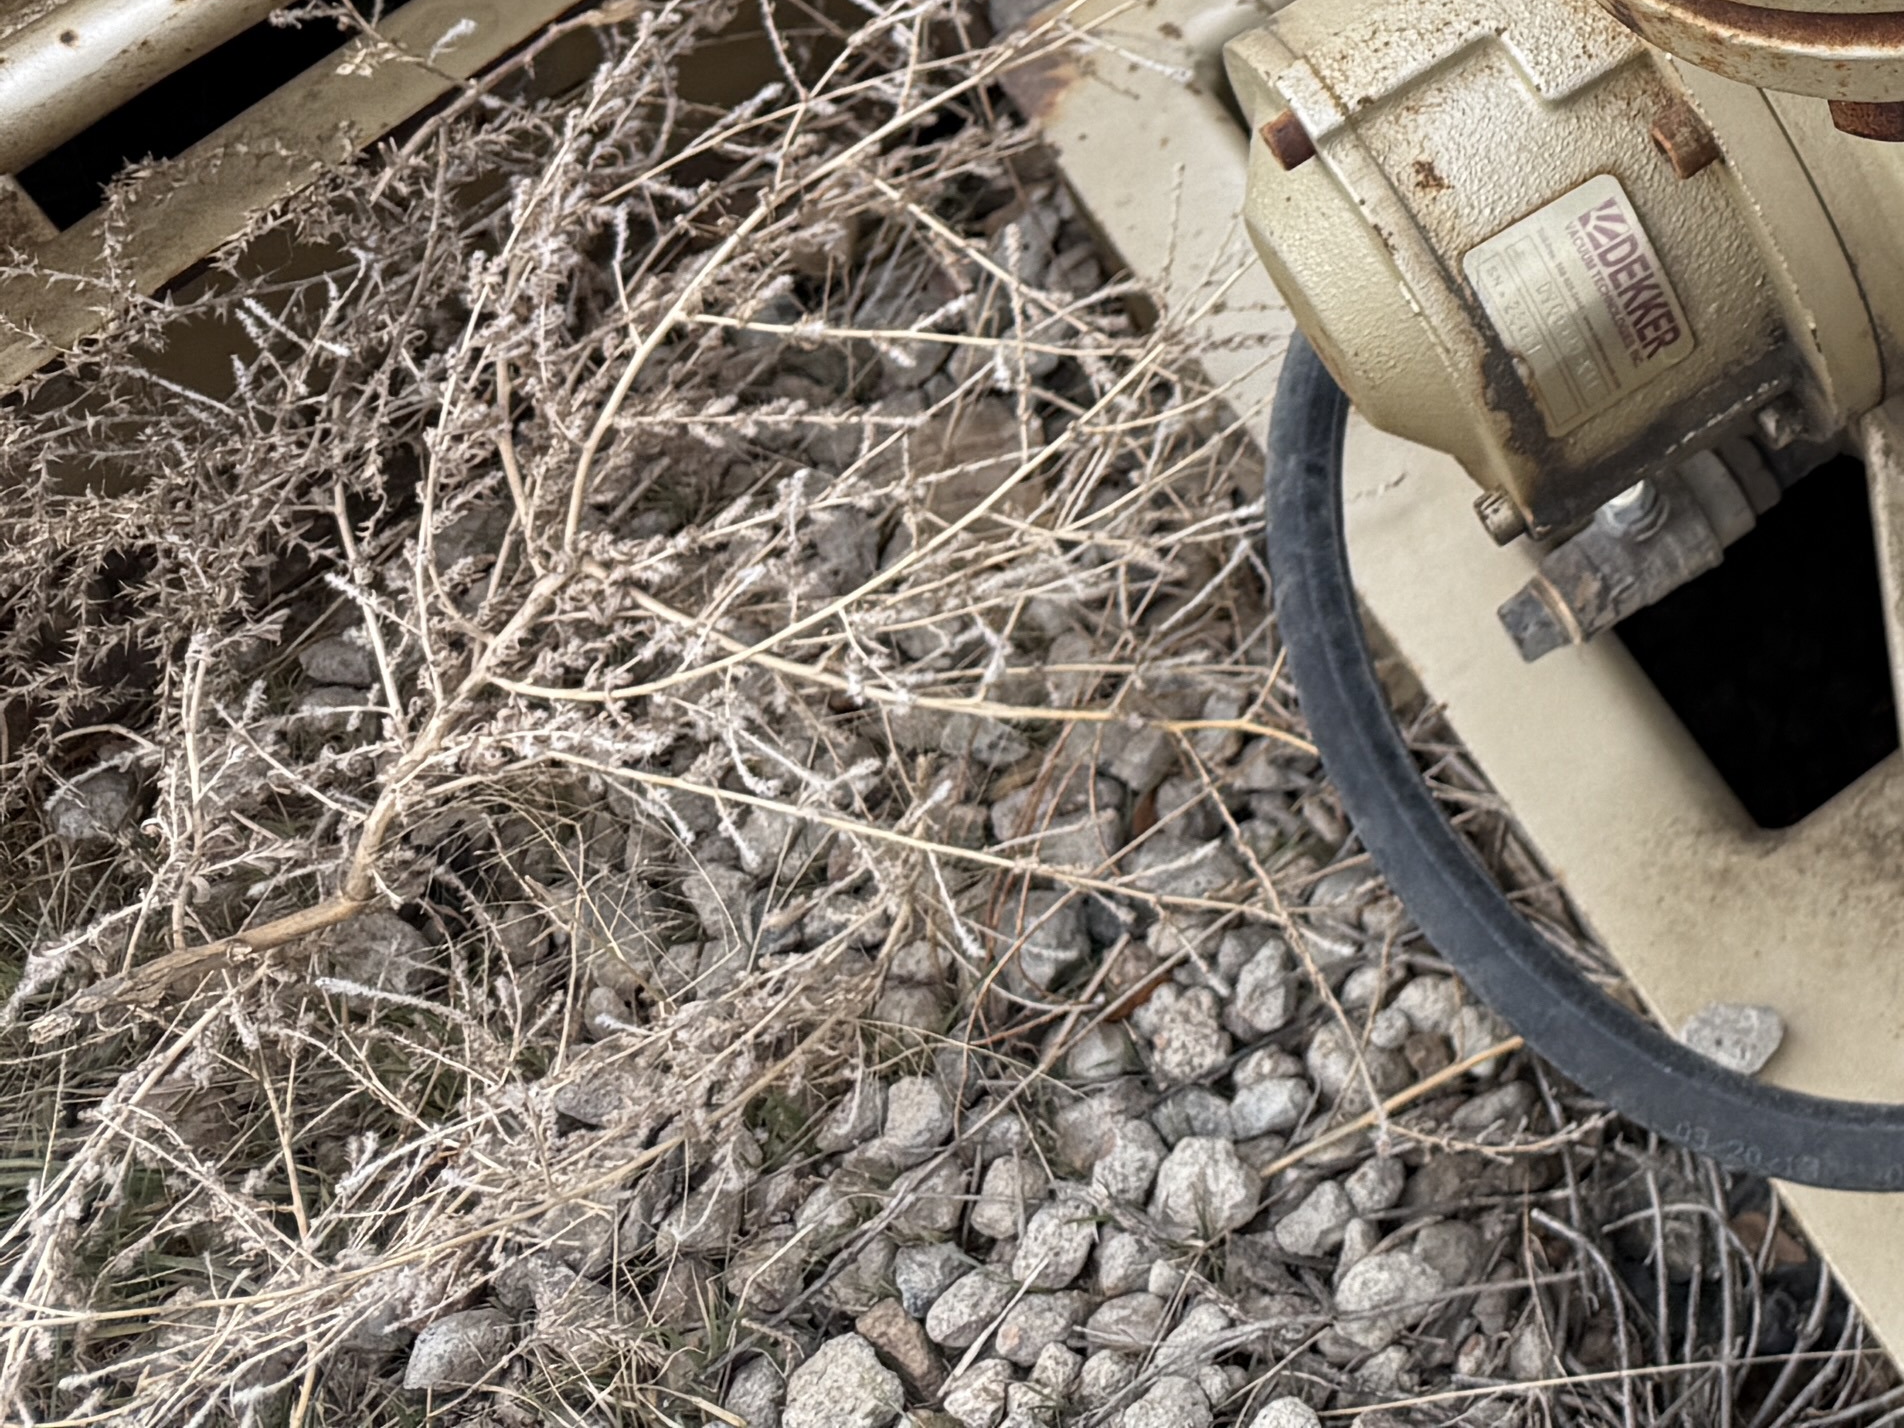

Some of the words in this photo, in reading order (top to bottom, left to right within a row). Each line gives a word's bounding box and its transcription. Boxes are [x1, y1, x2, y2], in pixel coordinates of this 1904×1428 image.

[1565, 221, 1599, 277] VACUUM
[1590, 269, 1636, 351] TECHNOLOGIES
[1597, 233, 1681, 360] DEKKER
